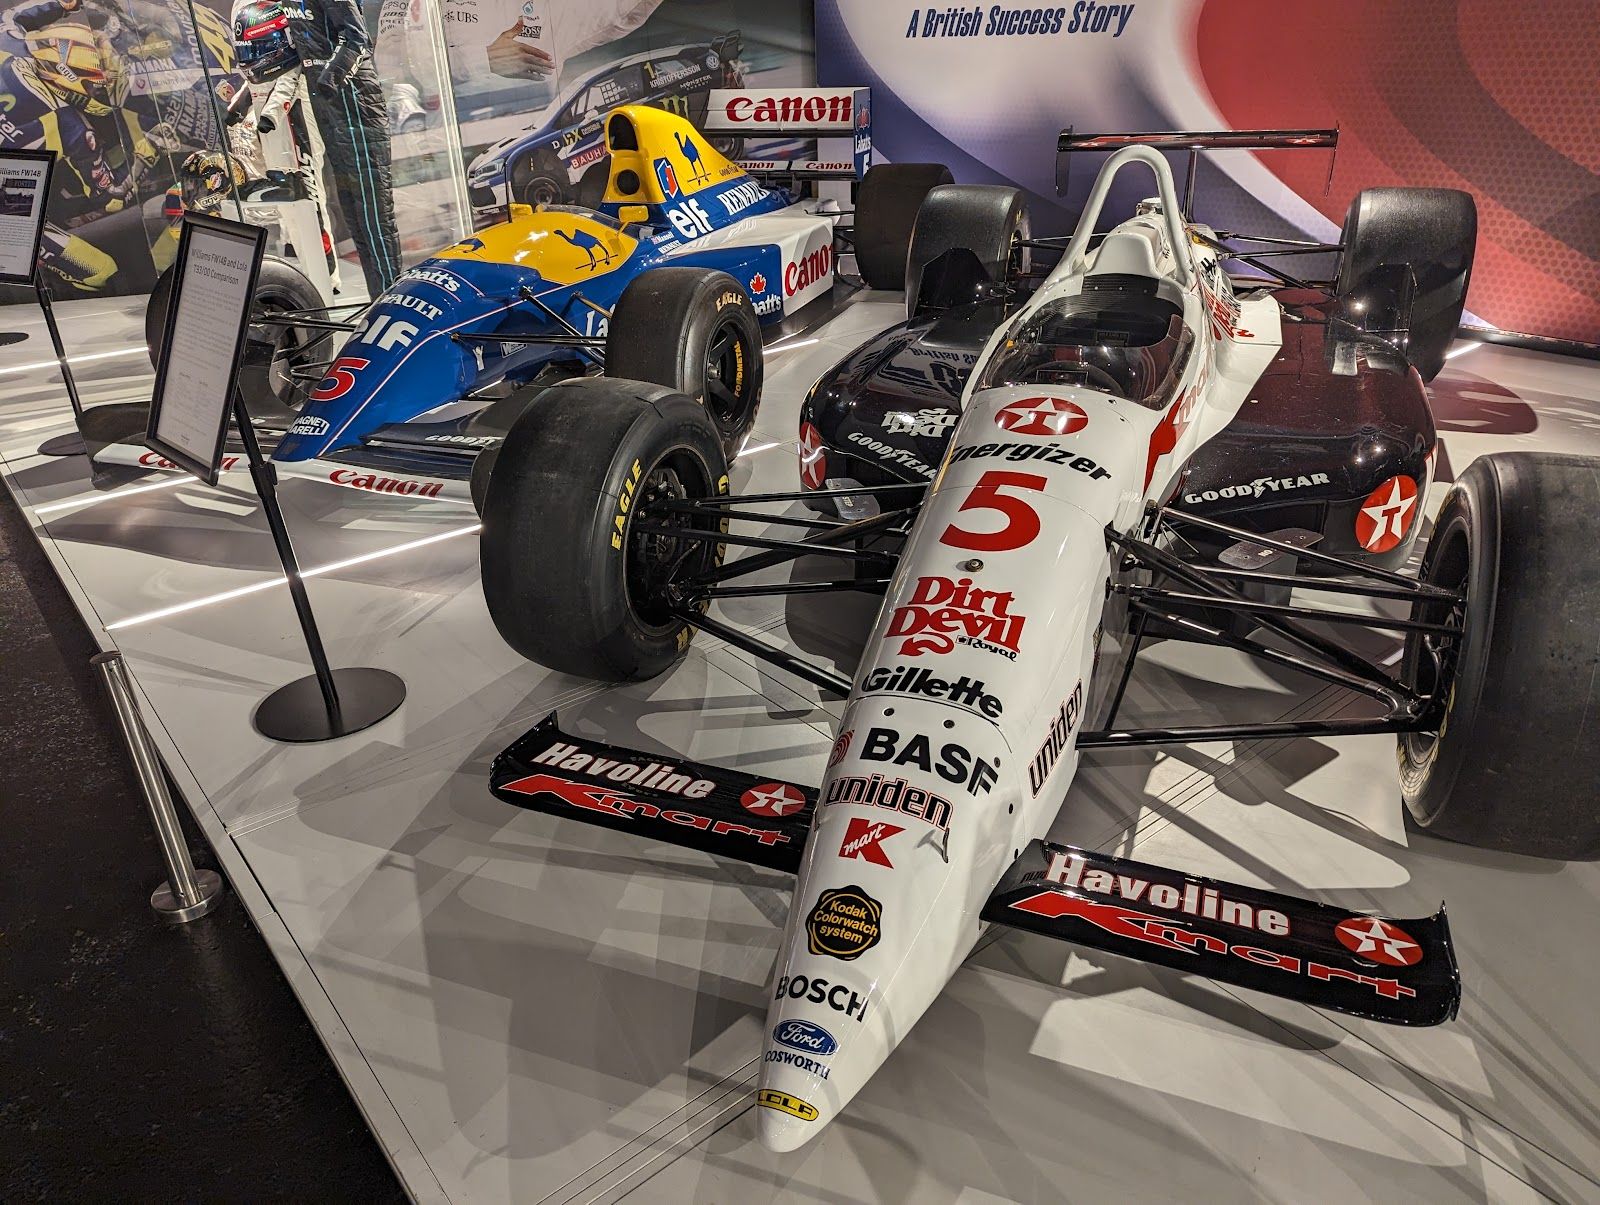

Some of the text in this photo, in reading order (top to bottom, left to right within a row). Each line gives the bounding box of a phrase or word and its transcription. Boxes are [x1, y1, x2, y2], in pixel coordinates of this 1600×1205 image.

[457, 12, 479, 23] UBS
[906, 1, 1135, 38] A British Success Story
[726, 96, 852, 122] Canon
[805, 162, 853, 170] Canon
[668, 198, 714, 238] elf
[715, 292, 743, 313] EAGLE
[308, 357, 371, 401] 5
[733, 341, 744, 398] FONDMETAL
[139, 452, 240, 471] Can
[330, 469, 444, 498] Canon
[1185, 472, 1330, 504] GOODYEAR
[611, 458, 642, 551] EAGLE
[939, 471, 1048, 552] 5
[907, 576, 1015, 618] Dirt
[884, 606, 1026, 654] Devil
[966, 637, 1018, 663] Royal
[861, 666, 1003, 719] Gillette
[1027, 678, 1083, 800] uniden
[532, 742, 717, 799] Havoline
[860, 727, 999, 797] BASF
[498, 773, 792, 846] Kmart
[823, 772, 954, 831] uniden
[830, 900, 868, 920] Kodak
[1045, 854, 1291, 936] Havoline
[813, 910, 879, 937] Colorwatch
[819, 924, 864, 945] system
[1008, 890, 1416, 1000] Kmart
[775, 975, 870, 1023] BOSCH
[781, 1022, 822, 1050] Ford
[764, 1050, 831, 1081] COSWORTH
